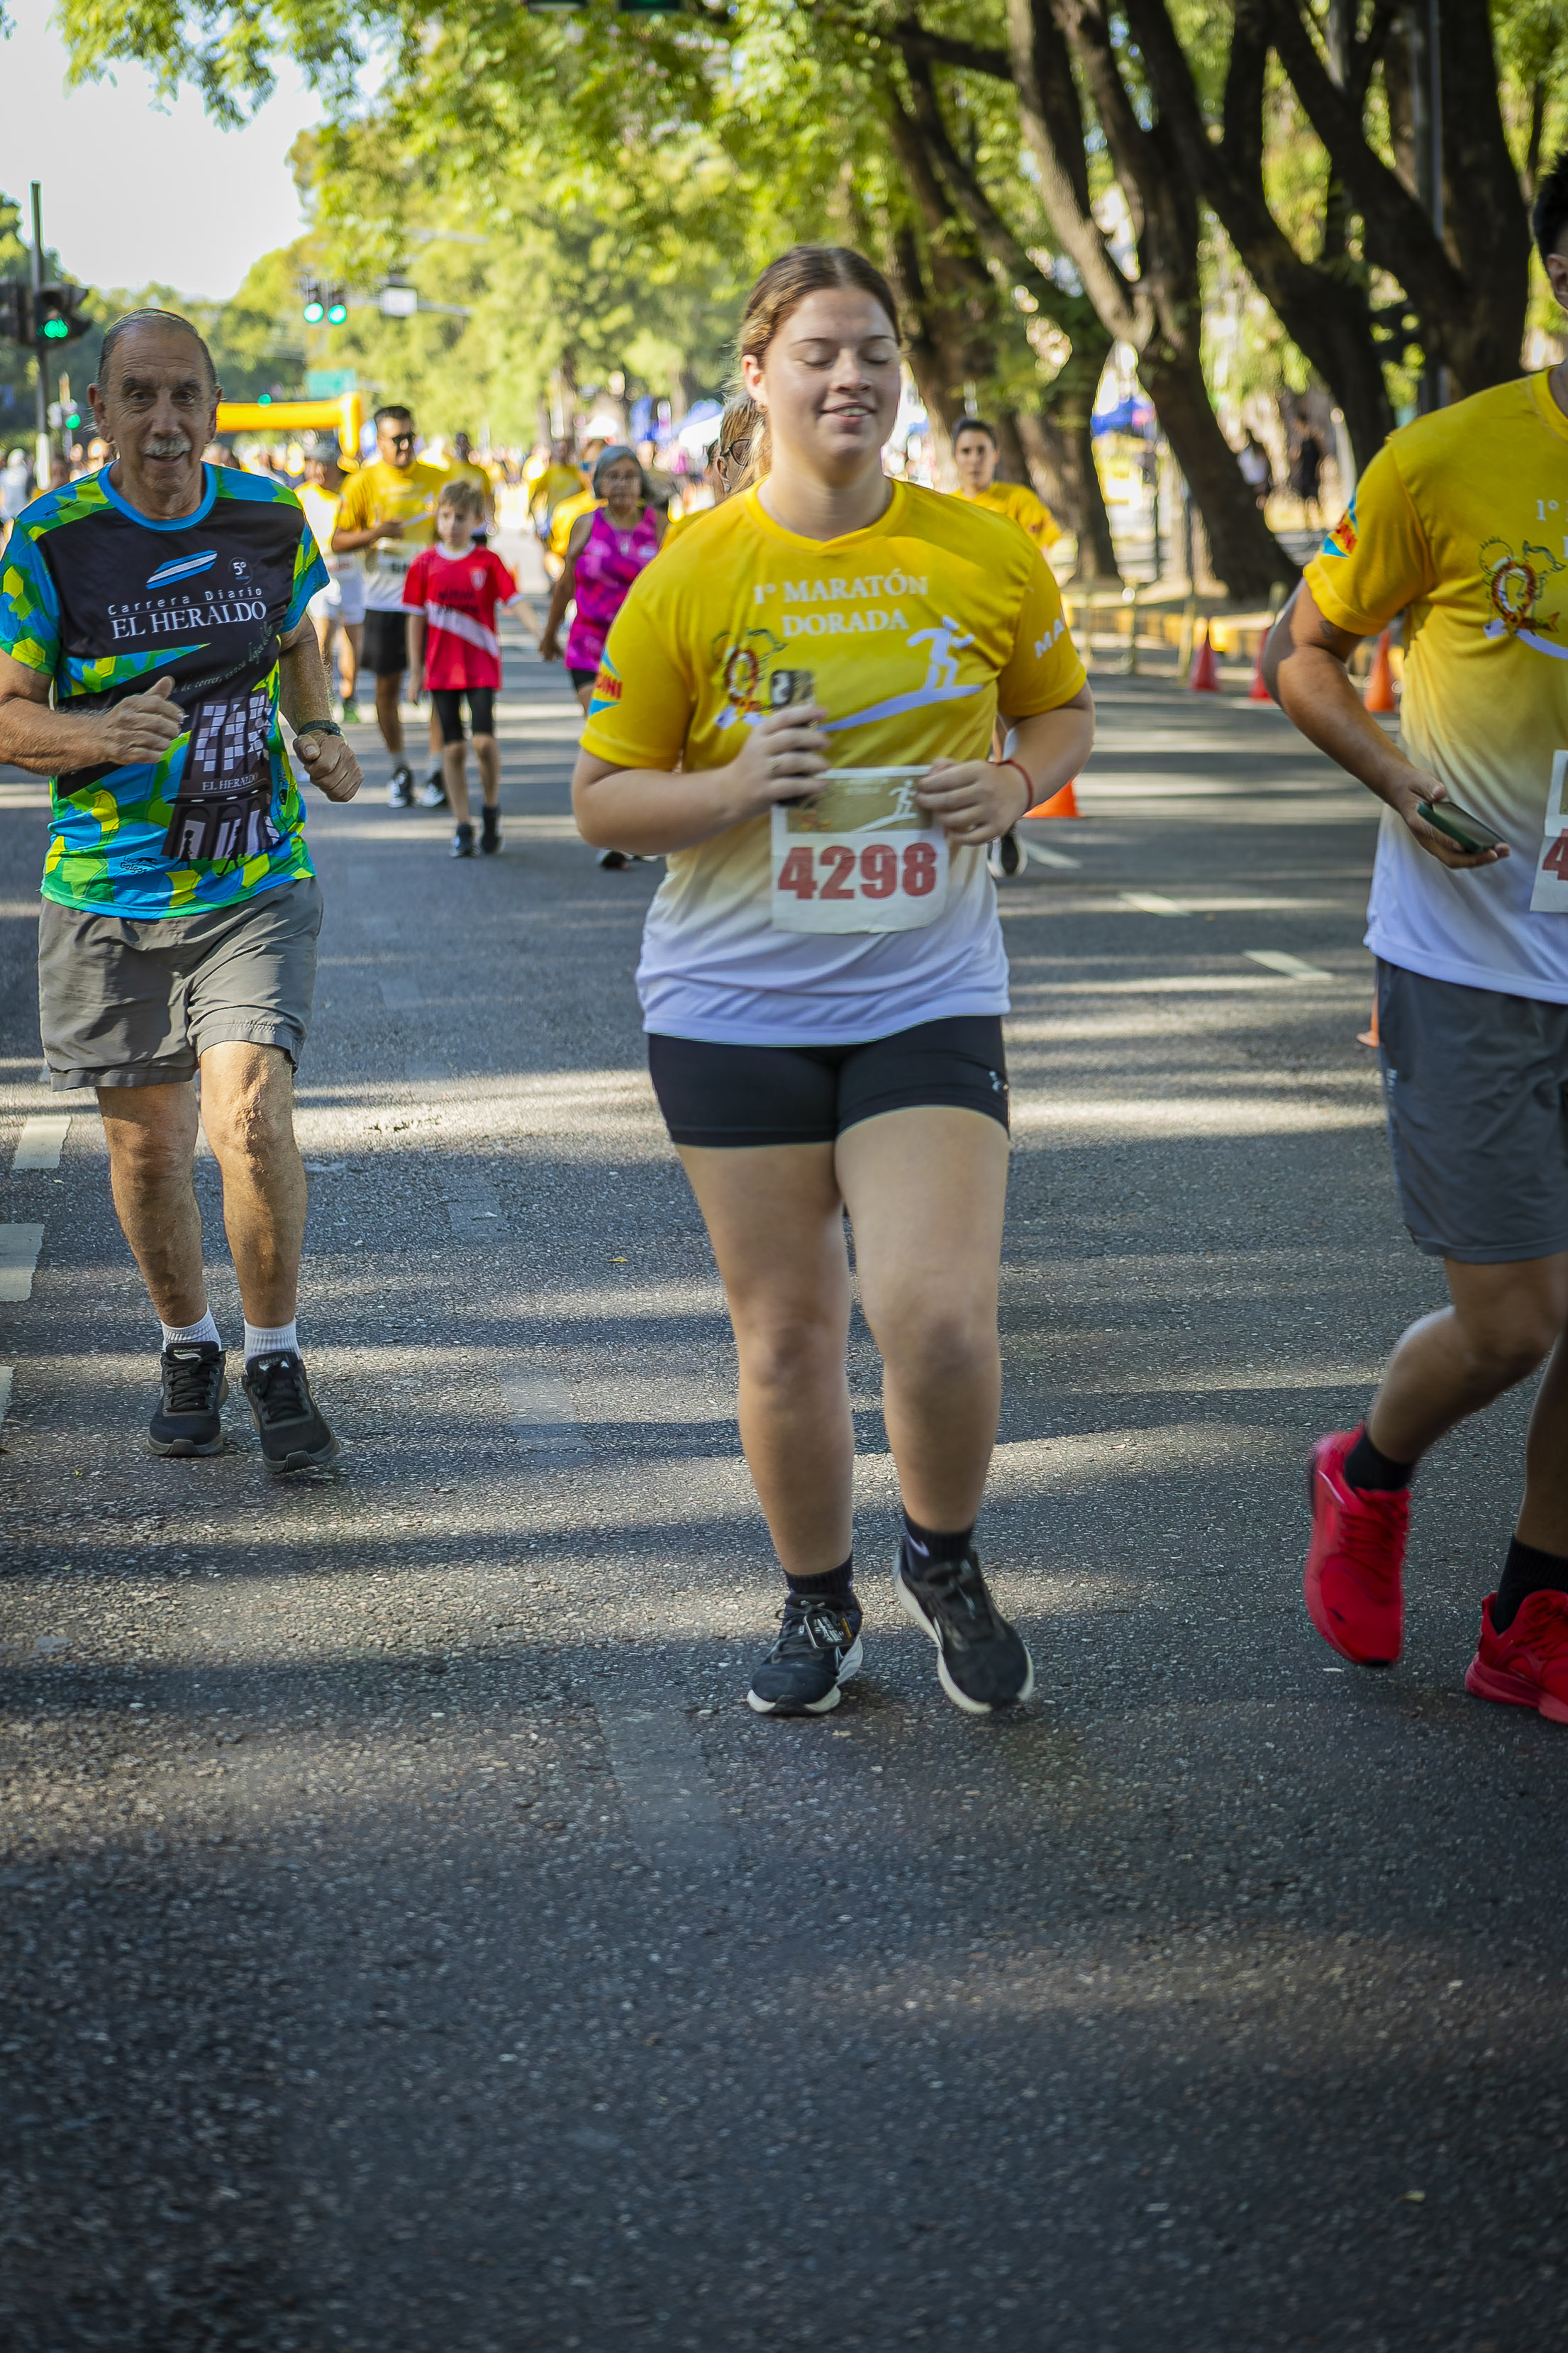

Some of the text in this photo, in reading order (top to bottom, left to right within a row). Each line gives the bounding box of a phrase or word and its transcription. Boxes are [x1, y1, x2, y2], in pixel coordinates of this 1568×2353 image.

[108, 587, 262, 615] Carrera Diario
[782, 568, 928, 604] MARATÓN
[111, 616, 146, 639] EL
[149, 601, 267, 633] HERALDO
[782, 608, 910, 638] DORADA
[202, 782, 217, 791] EL
[777, 842, 937, 899] 4298
